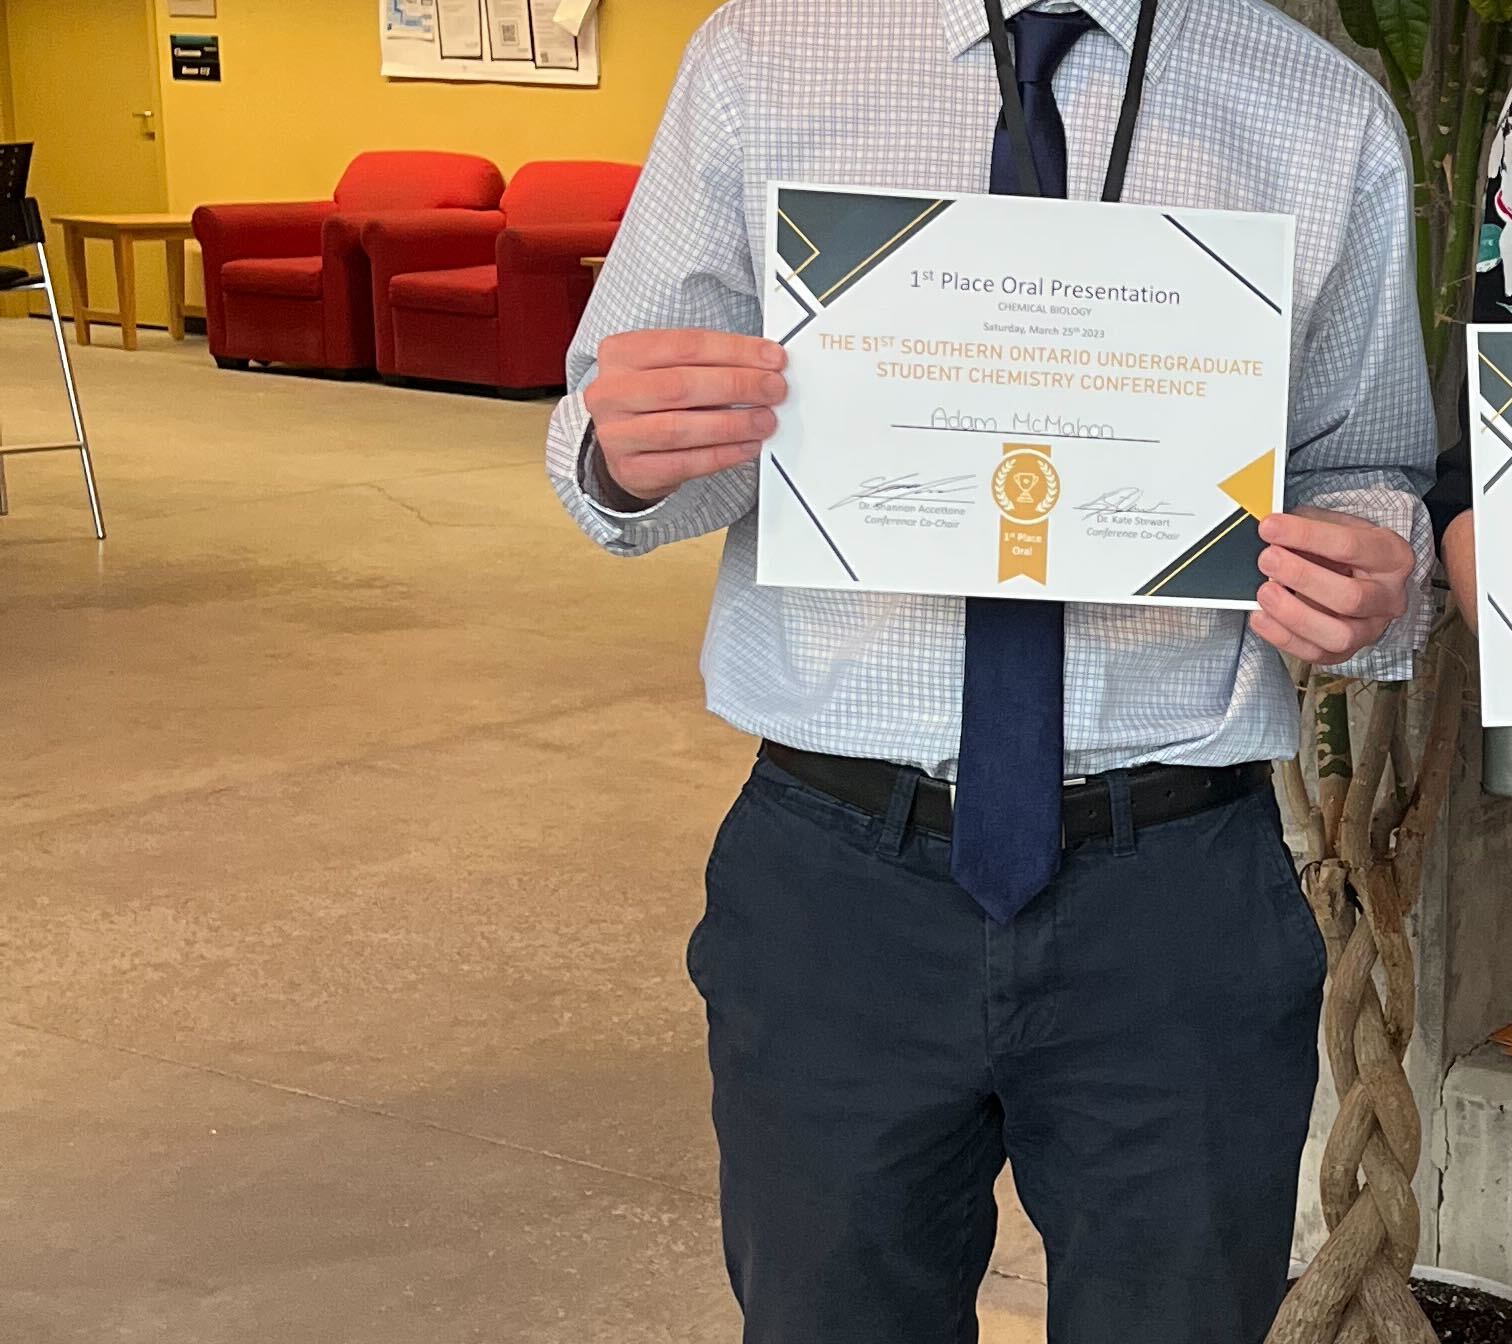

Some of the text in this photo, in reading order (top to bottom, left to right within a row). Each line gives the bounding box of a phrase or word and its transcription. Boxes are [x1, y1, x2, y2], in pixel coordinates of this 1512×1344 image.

[910, 269, 1181, 305] 1st Place Oral Presentation
[998, 302, 1093, 317] CHEMICAL BIOLOGY
[983, 321, 1026, 335] Saturday,
[1029, 324, 1060, 336] March
[1062, 327, 1081, 337] 25th
[819, 332, 1264, 377] THE 51ST SOUTHERN ONTARIO UNDERGRADUATE
[876, 361, 1208, 398] STUDENT CHEMISTRY CONFERENCE
[931, 406, 1115, 439] Adam McMahon
[1112, 515, 1133, 526] Kate
[1134, 516, 1171, 527] Stewart
[1017, 533, 1043, 544] Place
[1086, 526, 1180, 542] Conference Co-Chair
[1012, 545, 1033, 556] Oral
